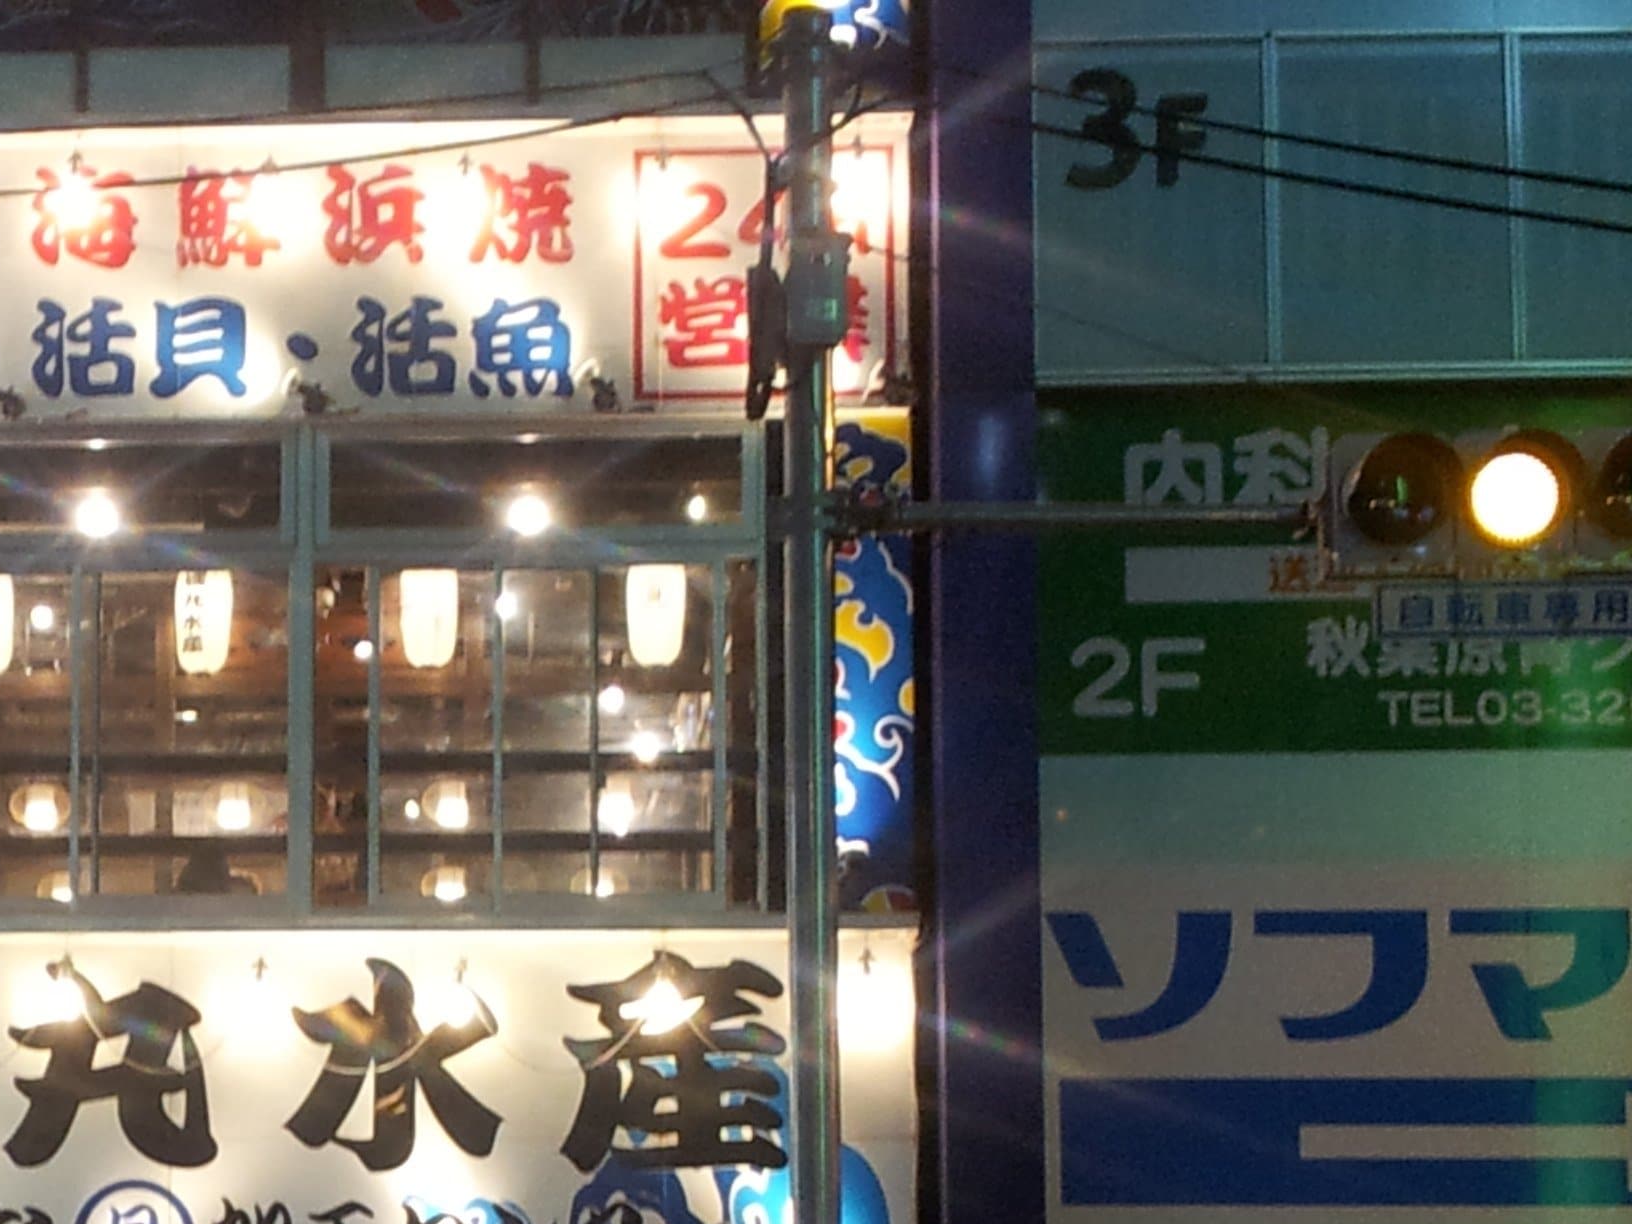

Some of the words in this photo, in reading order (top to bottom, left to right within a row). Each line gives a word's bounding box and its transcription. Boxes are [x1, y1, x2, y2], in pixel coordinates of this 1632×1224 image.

[1065, 68, 1209, 189] 3F
[30, 296, 576, 399] 活貝・活魚
[1071, 637, 1207, 718] 2F
[1045, 908, 1632, 1042] ソフマ
